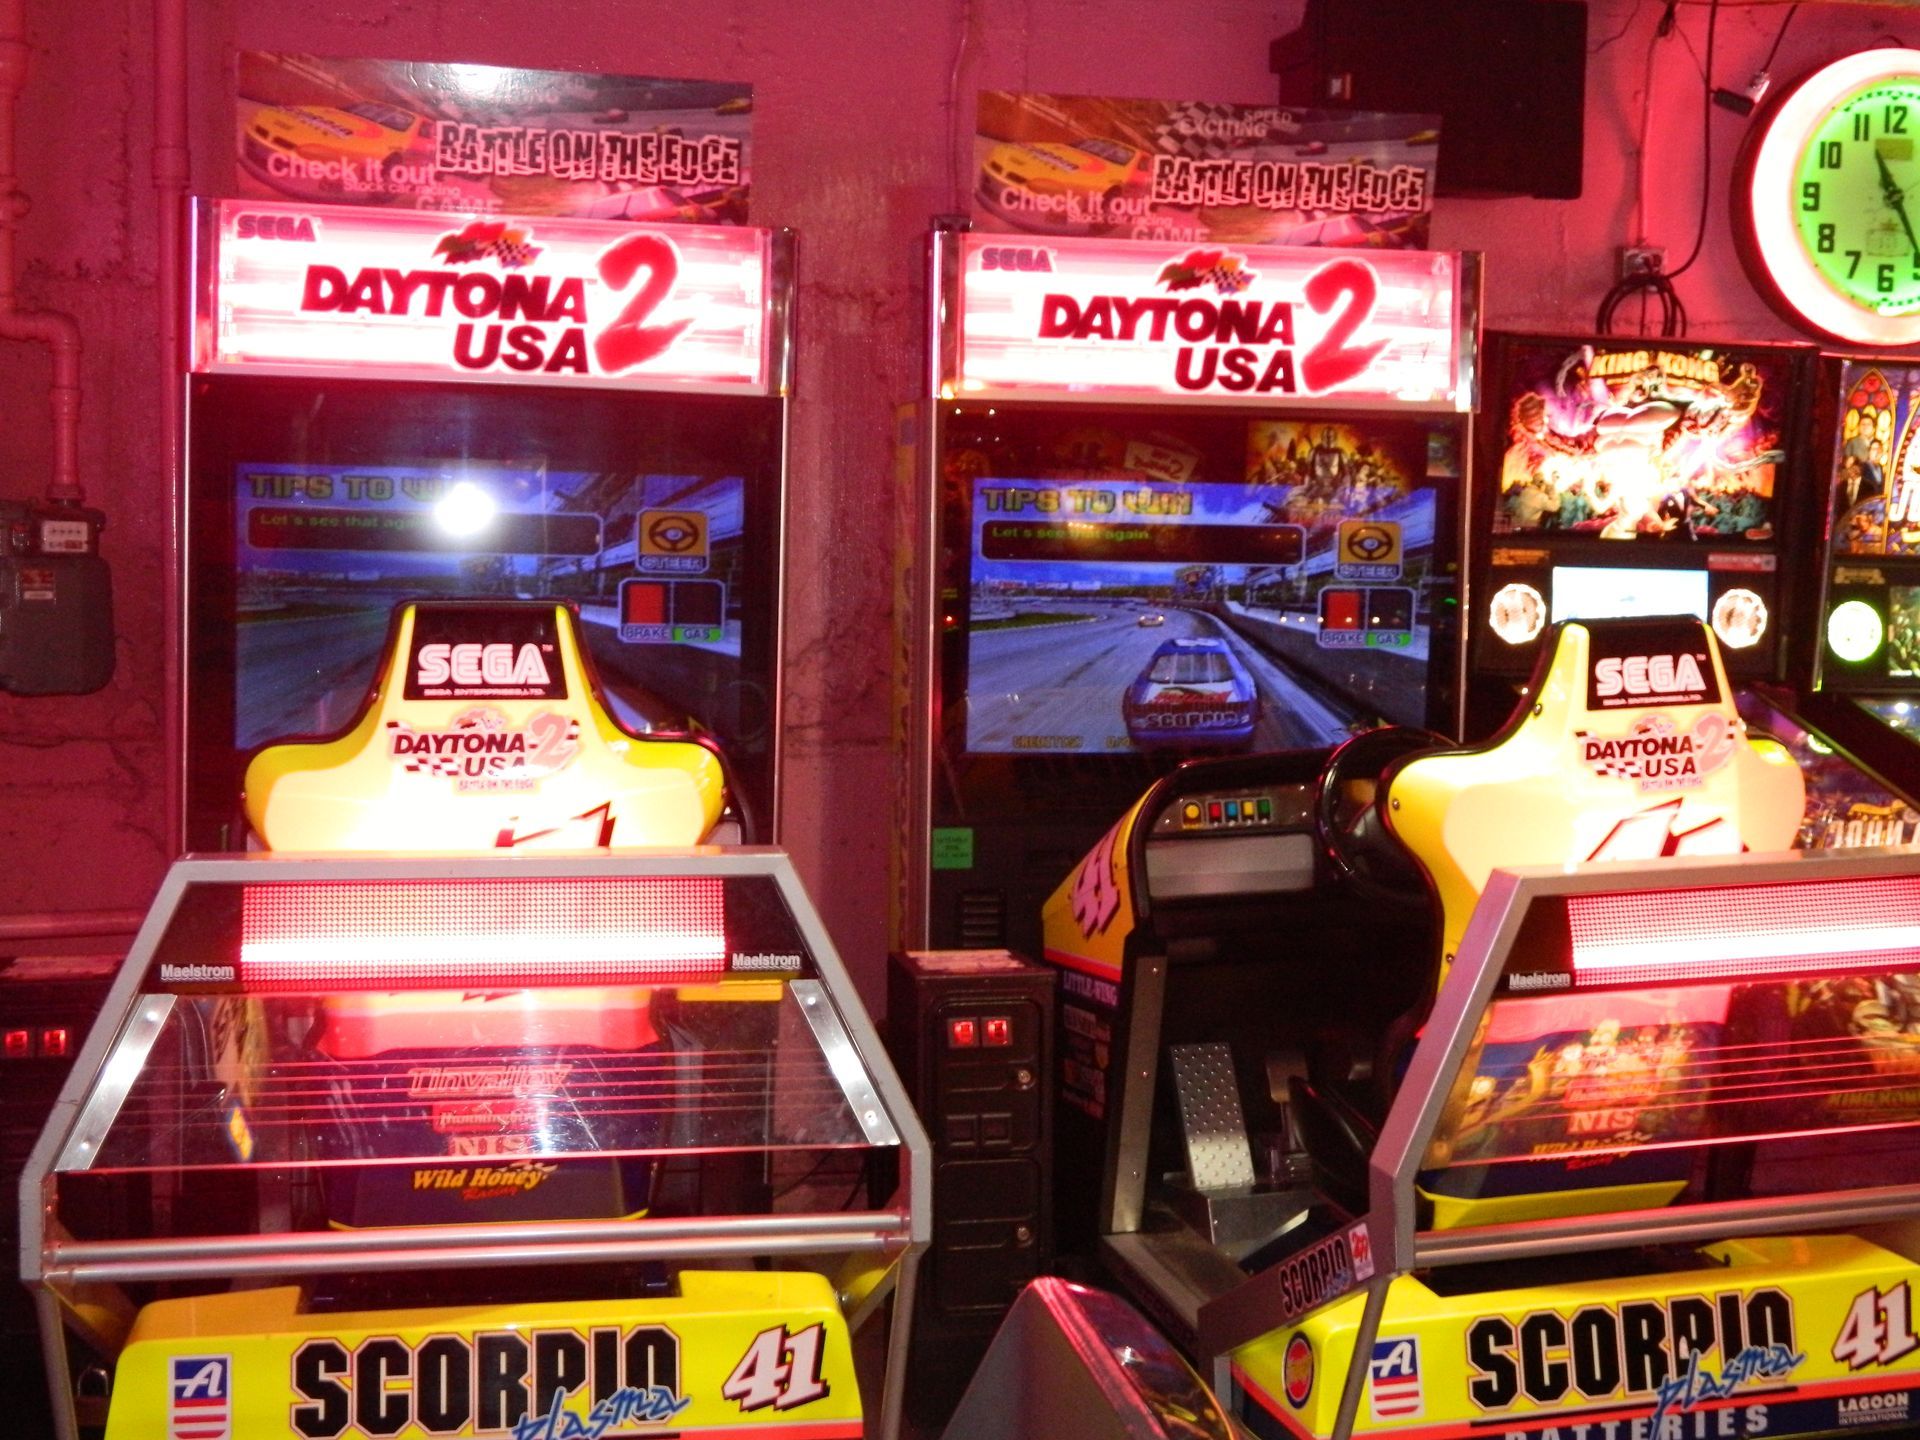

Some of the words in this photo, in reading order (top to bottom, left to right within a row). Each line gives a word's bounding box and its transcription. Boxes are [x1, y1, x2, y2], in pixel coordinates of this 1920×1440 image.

[1854, 114, 1870, 141] 11
[1884, 105, 1908, 134] 12
[436, 121, 547, 176] BATTLE
[550, 129, 597, 180] ON
[601, 131, 659, 183] THE
[661, 133, 742, 184] EDGE
[1820, 141, 1841, 168] 10
[267, 153, 358, 182] Check
[390, 163, 437, 185] out
[1153, 154, 1253, 206] BATTLE
[1254, 161, 1297, 209] ON
[1299, 162, 1352, 211] THE
[1353, 164, 1426, 212] EDGE
[1000, 187, 1081, 216] Check
[1110, 195, 1152, 217] out
[1802, 182, 1820, 211] 9
[237, 215, 316, 242] SEGA
[1817, 224, 1835, 253] 8
[981, 247, 1053, 272] SEGA
[1844, 252, 1861, 279] 7
[1877, 264, 1894, 292] 6
[301, 264, 588, 323] DAYTONA
[594, 233, 697, 375] 2
[1038, 294, 1296, 345] DAYTONA
[1302, 258, 1392, 394] 2
[453, 324, 590, 374] USA
[1175, 348, 1297, 394] USA
[1588, 350, 1650, 377] KING
[1657, 351, 1719, 382] KONG
[248, 474, 333, 499] TIPS
[342, 475, 394, 501] TO
[982, 488, 1060, 512] TIPS
[1067, 489, 1116, 513] TO
[418, 643, 551, 685] SEGA
[1595, 653, 1707, 697] SEGA
[394, 733, 525, 754] DAYTONA
[1586, 736, 1694, 761] DAYTONA
[1645, 756, 1697, 777] USA
[160, 963, 235, 979] Maelstrom
[732, 951, 801, 968] Maelstrom
[1508, 972, 1572, 988] Maelstrom
[413, 1169, 468, 1189] Wild
[469, 1167, 544, 1190] Honey
[1279, 1234, 1349, 1318] SCORPIO
[1831, 1280, 1919, 1371] 41
[1465, 1286, 1799, 1415] SCORPIO
[290, 1323, 681, 1440] SCORPIO
[722, 1322, 829, 1415] 41
[1838, 1391, 1910, 1414] LAGOON
